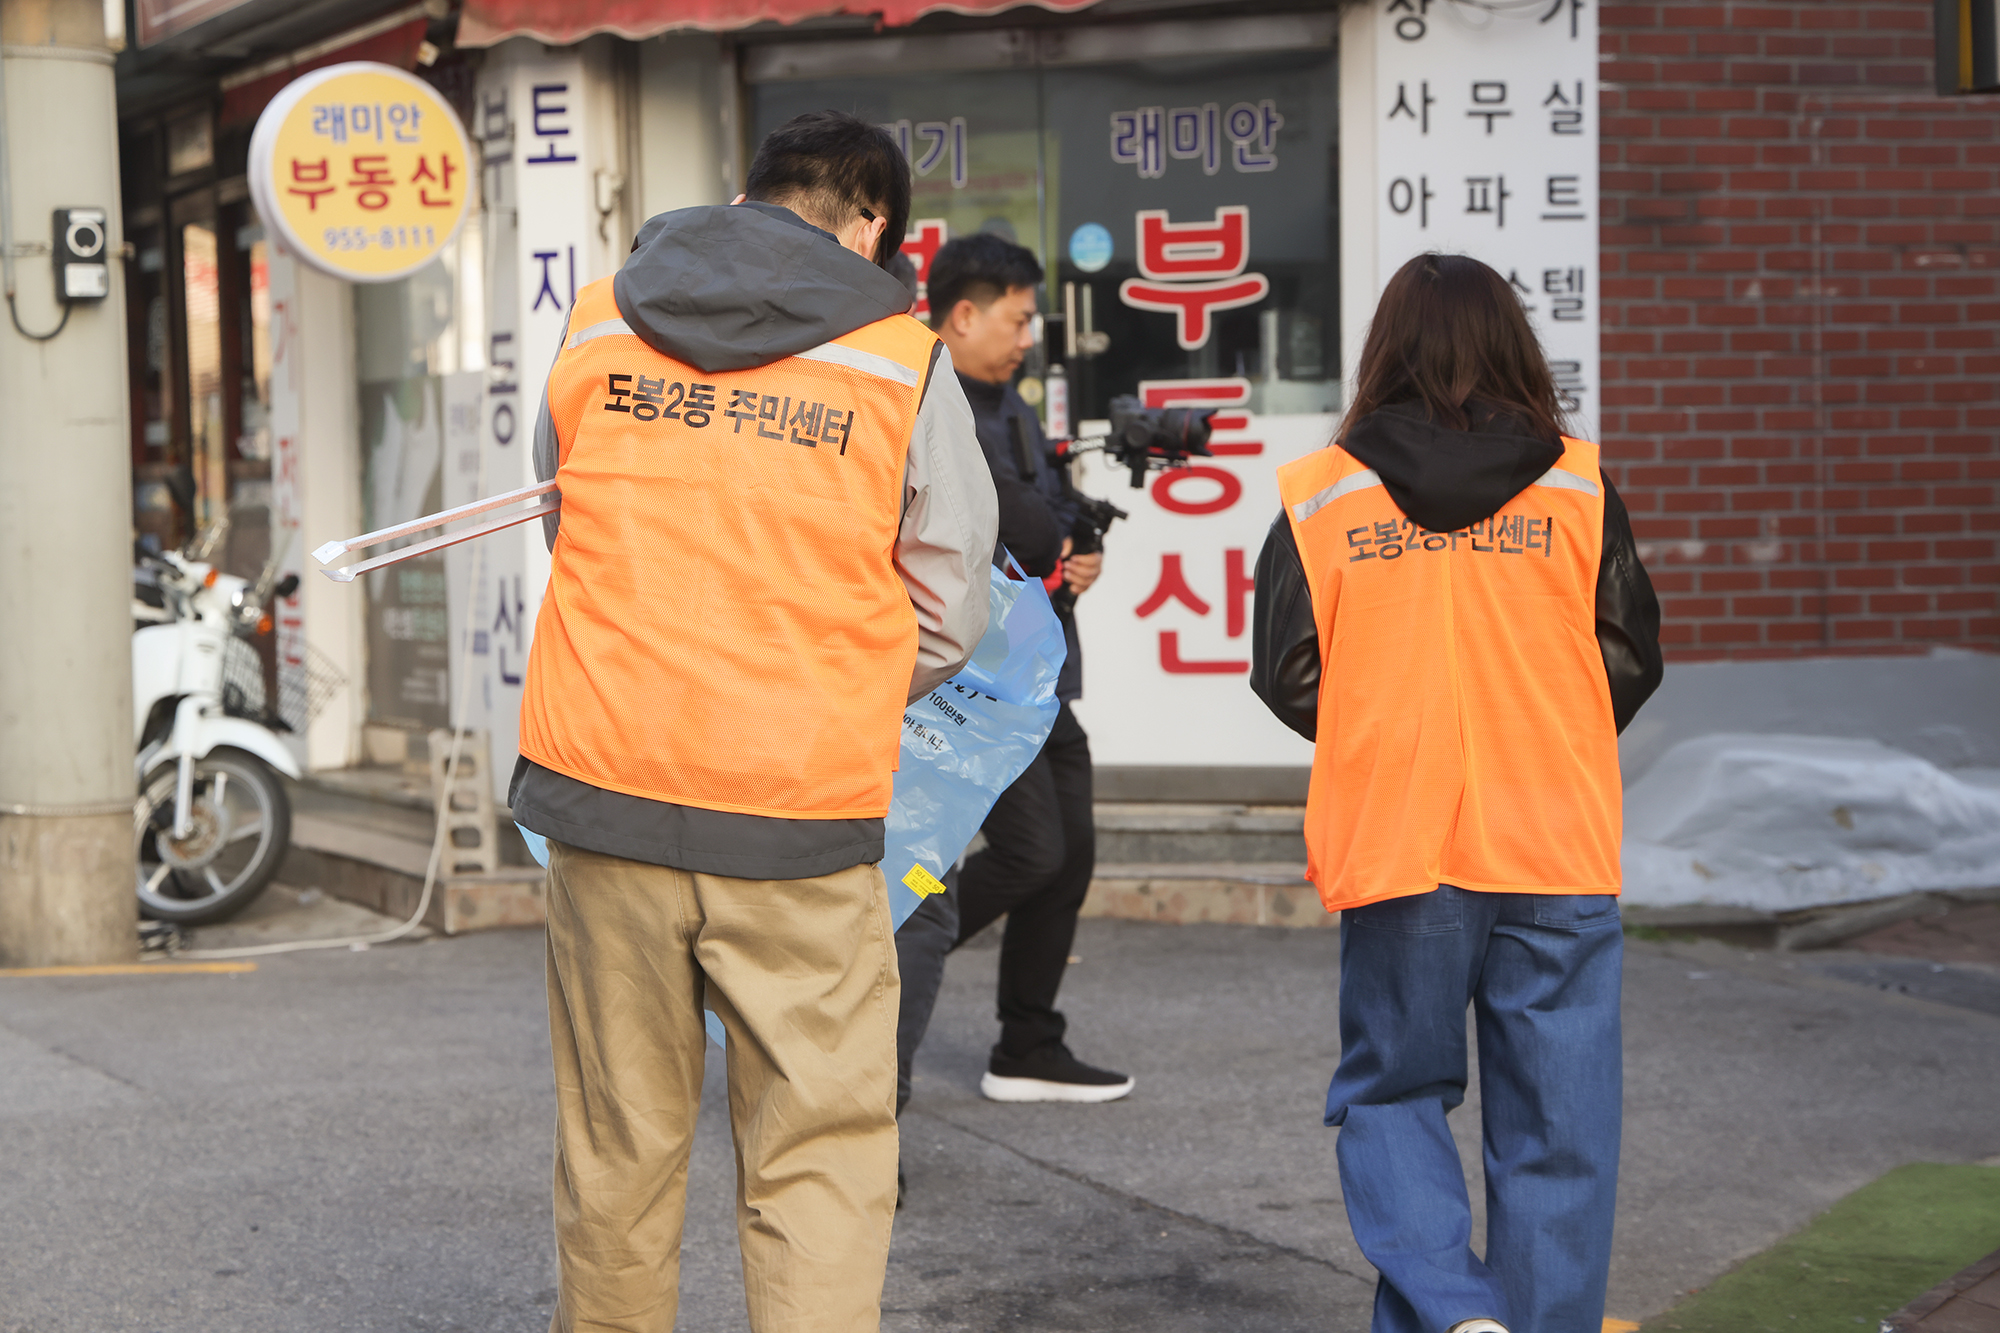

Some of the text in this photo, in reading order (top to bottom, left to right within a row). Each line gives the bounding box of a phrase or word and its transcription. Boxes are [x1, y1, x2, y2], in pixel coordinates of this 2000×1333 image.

[312, 102, 424, 144] 래미안
[1388, 79, 1585, 136] 사무실
[1112, 102, 1282, 177] 래미안
[288, 154, 457, 211] 부동산
[527, 84, 577, 311] 토지
[1388, 174, 1587, 229] 아파트
[323, 225, 435, 250] 955-8111
[604, 373, 854, 456] 도봉2동 주민센터
[1120, 206, 1268, 675] 부동산
[902, 713, 944, 752] 야 합니다.
[928, 691, 967, 727] 100만원
